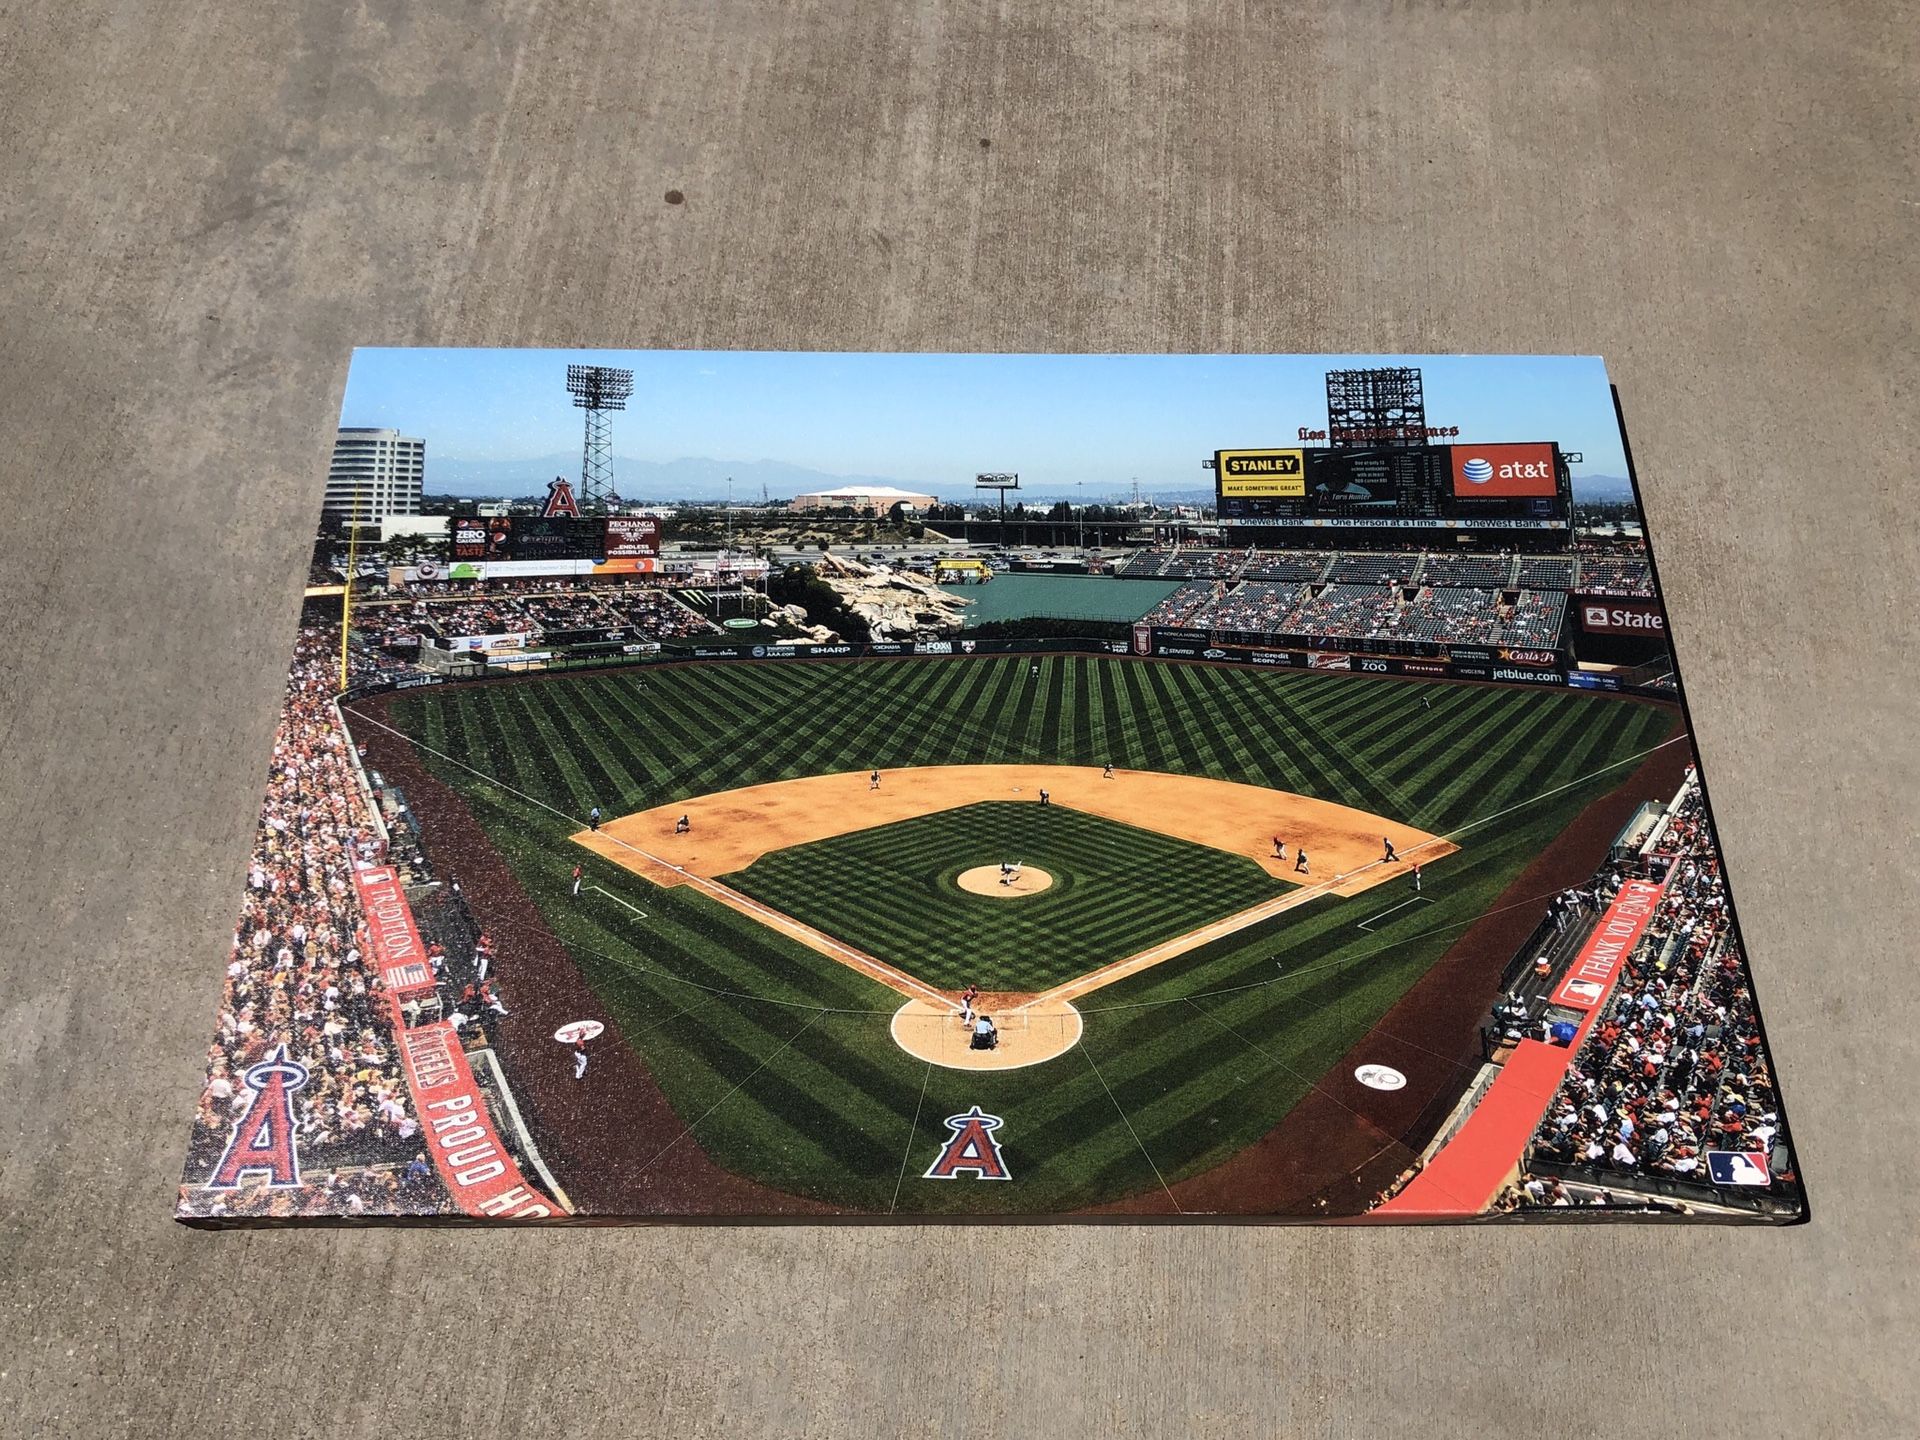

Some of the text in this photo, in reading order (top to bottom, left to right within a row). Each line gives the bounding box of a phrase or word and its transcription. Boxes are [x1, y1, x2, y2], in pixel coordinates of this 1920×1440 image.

[1298, 425, 1459, 441] Los Angeles Times
[1231, 460, 1294, 471] STANLEY
[1499, 461, 1549, 478] at&t
[1331, 519, 1351, 527] One
[1353, 519, 1387, 527] Person
[1390, 519, 1401, 527] at
[1465, 520, 1542, 528] OneWest Bank
[456, 531, 486, 539] ZERO
[1611, 610, 1663, 629] State
[926, 641, 947, 650] FOX
[1252, 651, 1289, 659] freecredit
[1509, 650, 1538, 660] Carl's
[1362, 663, 1387, 671] ZOO
[1404, 664, 1444, 672] Firestone
[1493, 668, 1562, 682] jetblue.com
[1579, 938, 1626, 979] THANK
[1603, 916, 1637, 938] YOU
[403, 1027, 459, 1090] ANGELS
[203, 1044, 309, 1190] A
[427, 1094, 506, 1187] PROUD
[922, 1105, 1013, 1180] A
